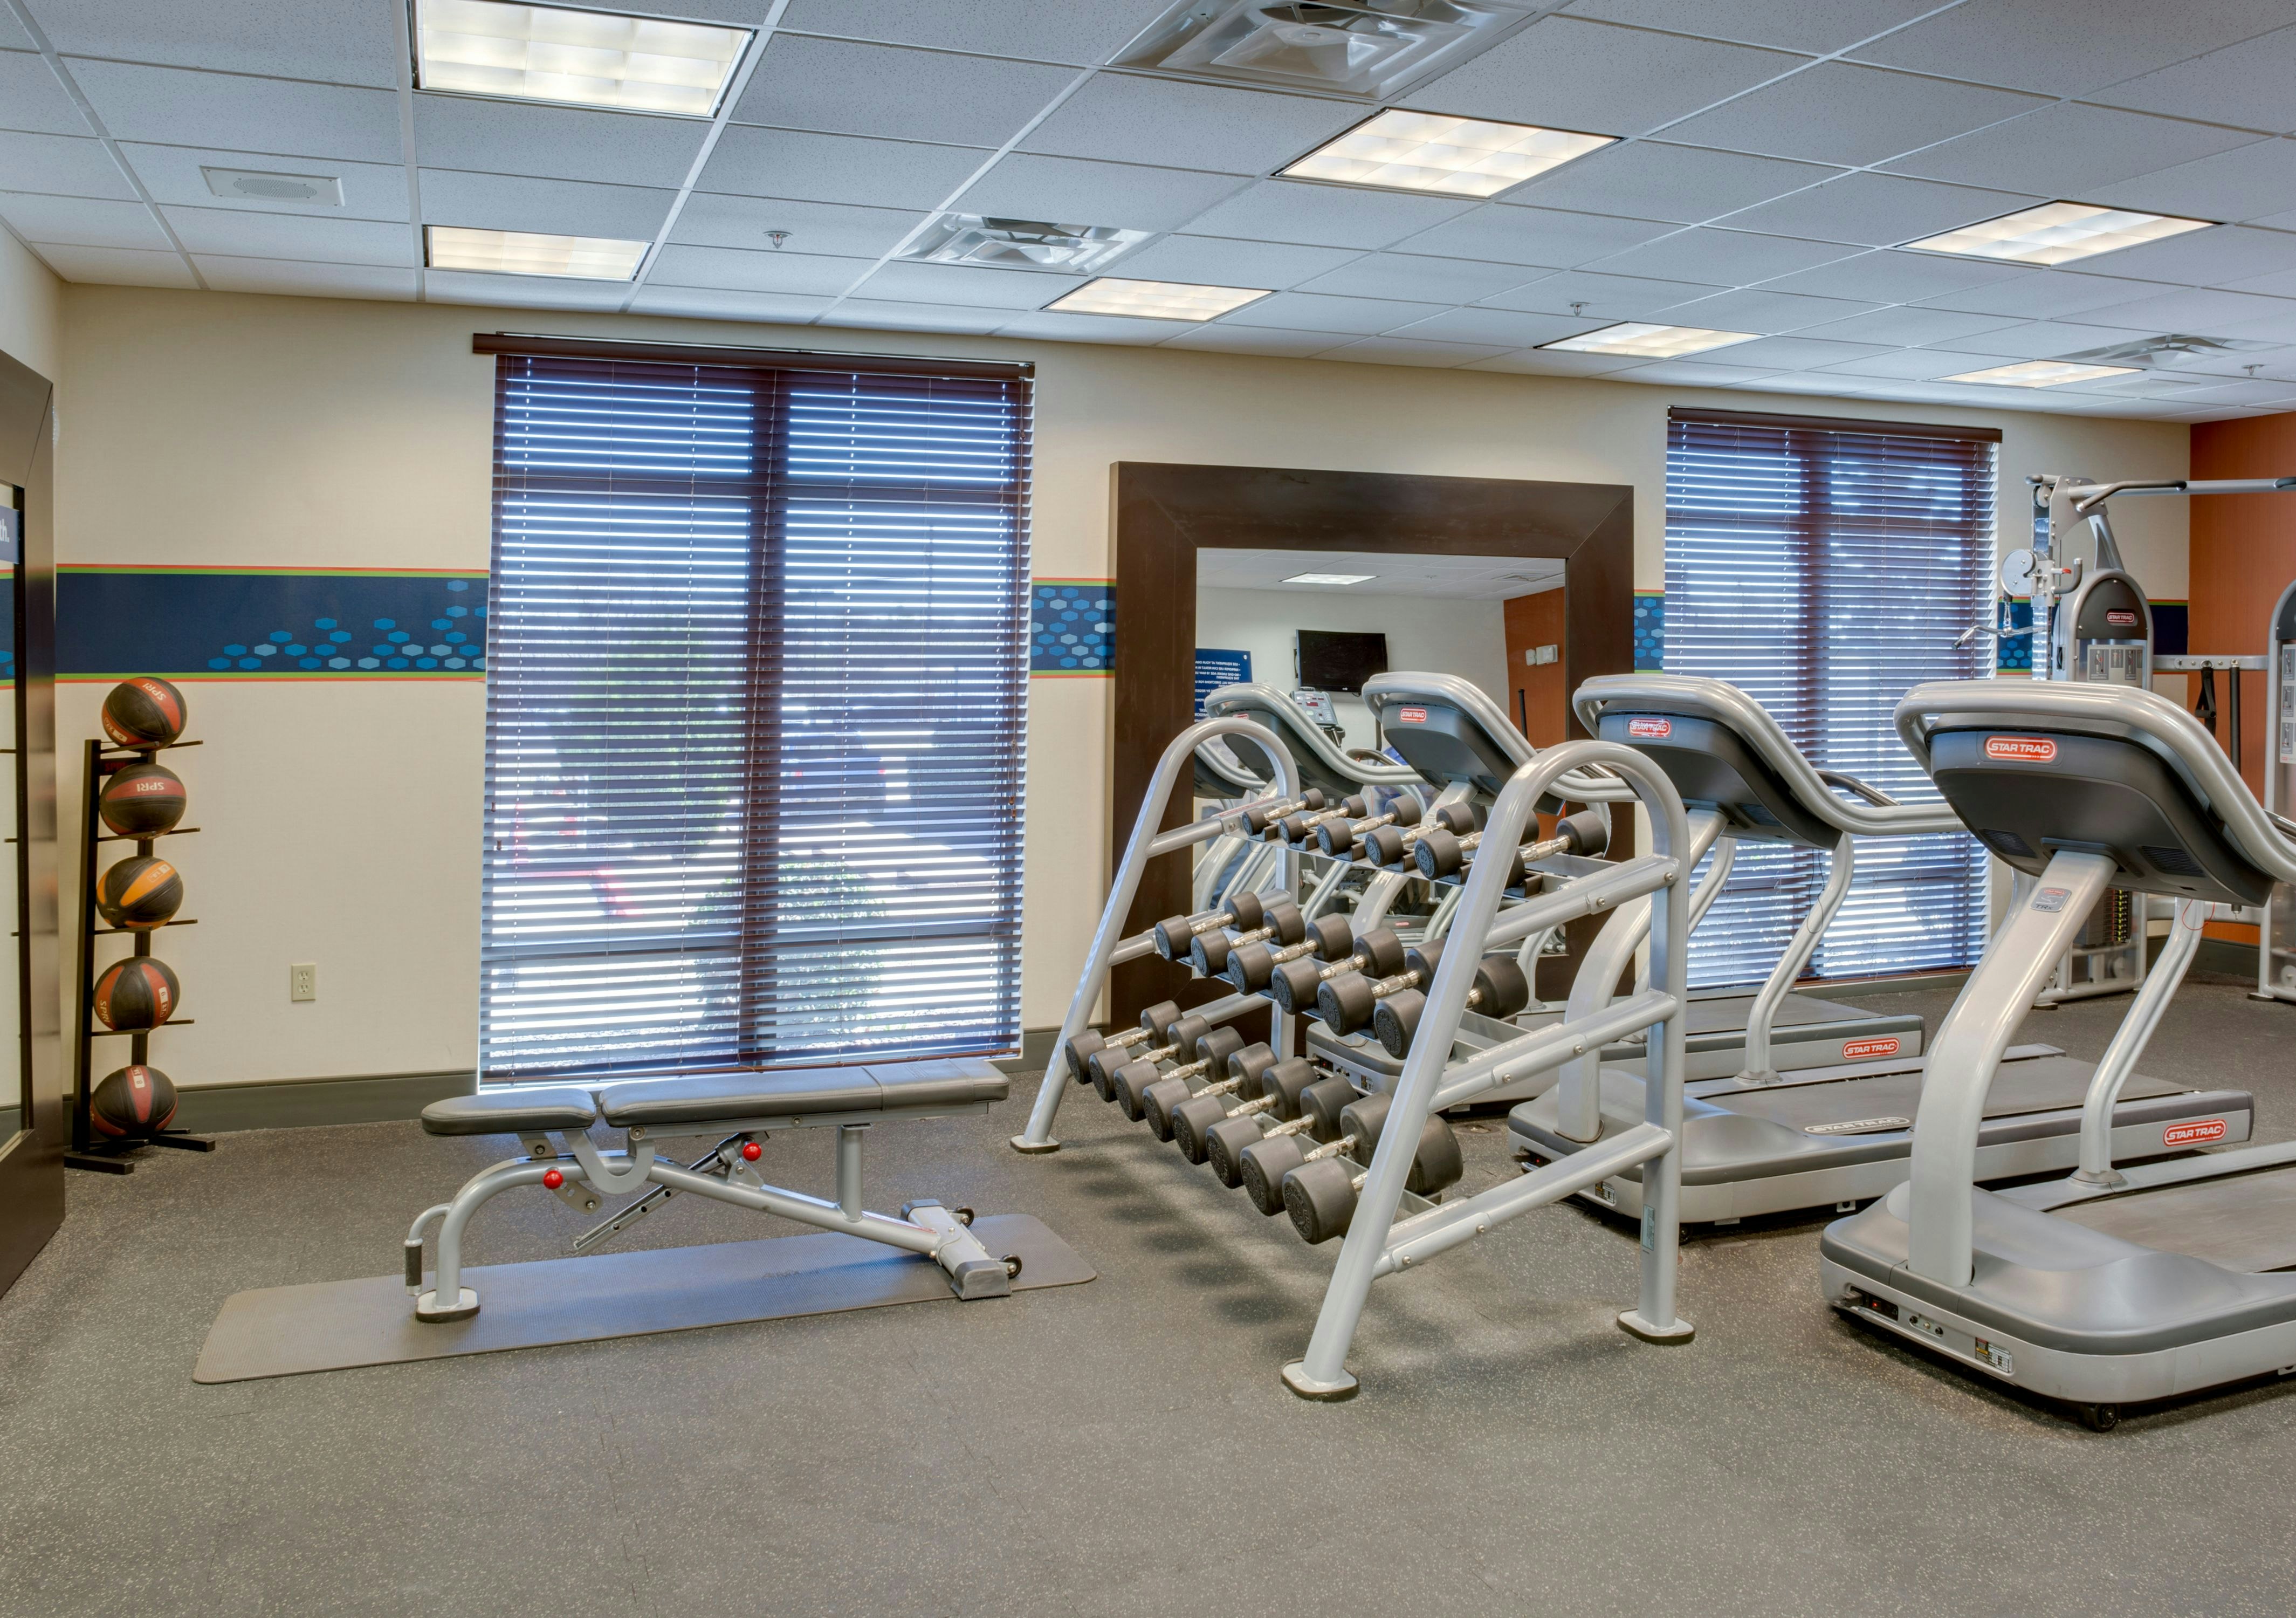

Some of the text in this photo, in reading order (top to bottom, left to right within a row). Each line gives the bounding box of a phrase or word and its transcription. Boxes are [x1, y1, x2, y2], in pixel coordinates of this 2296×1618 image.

[142, 683, 166, 701] SPRI
[1989, 743, 2050, 753] STAR TRAC
[137, 783, 164, 792] SPRI
[100, 999, 111, 1023] SPRI
[1845, 1043, 1895, 1054] STAR TRAC
[1813, 1119, 1900, 1132] STAR TRAC
[2167, 1126, 2222, 1140] STAR TRAC
